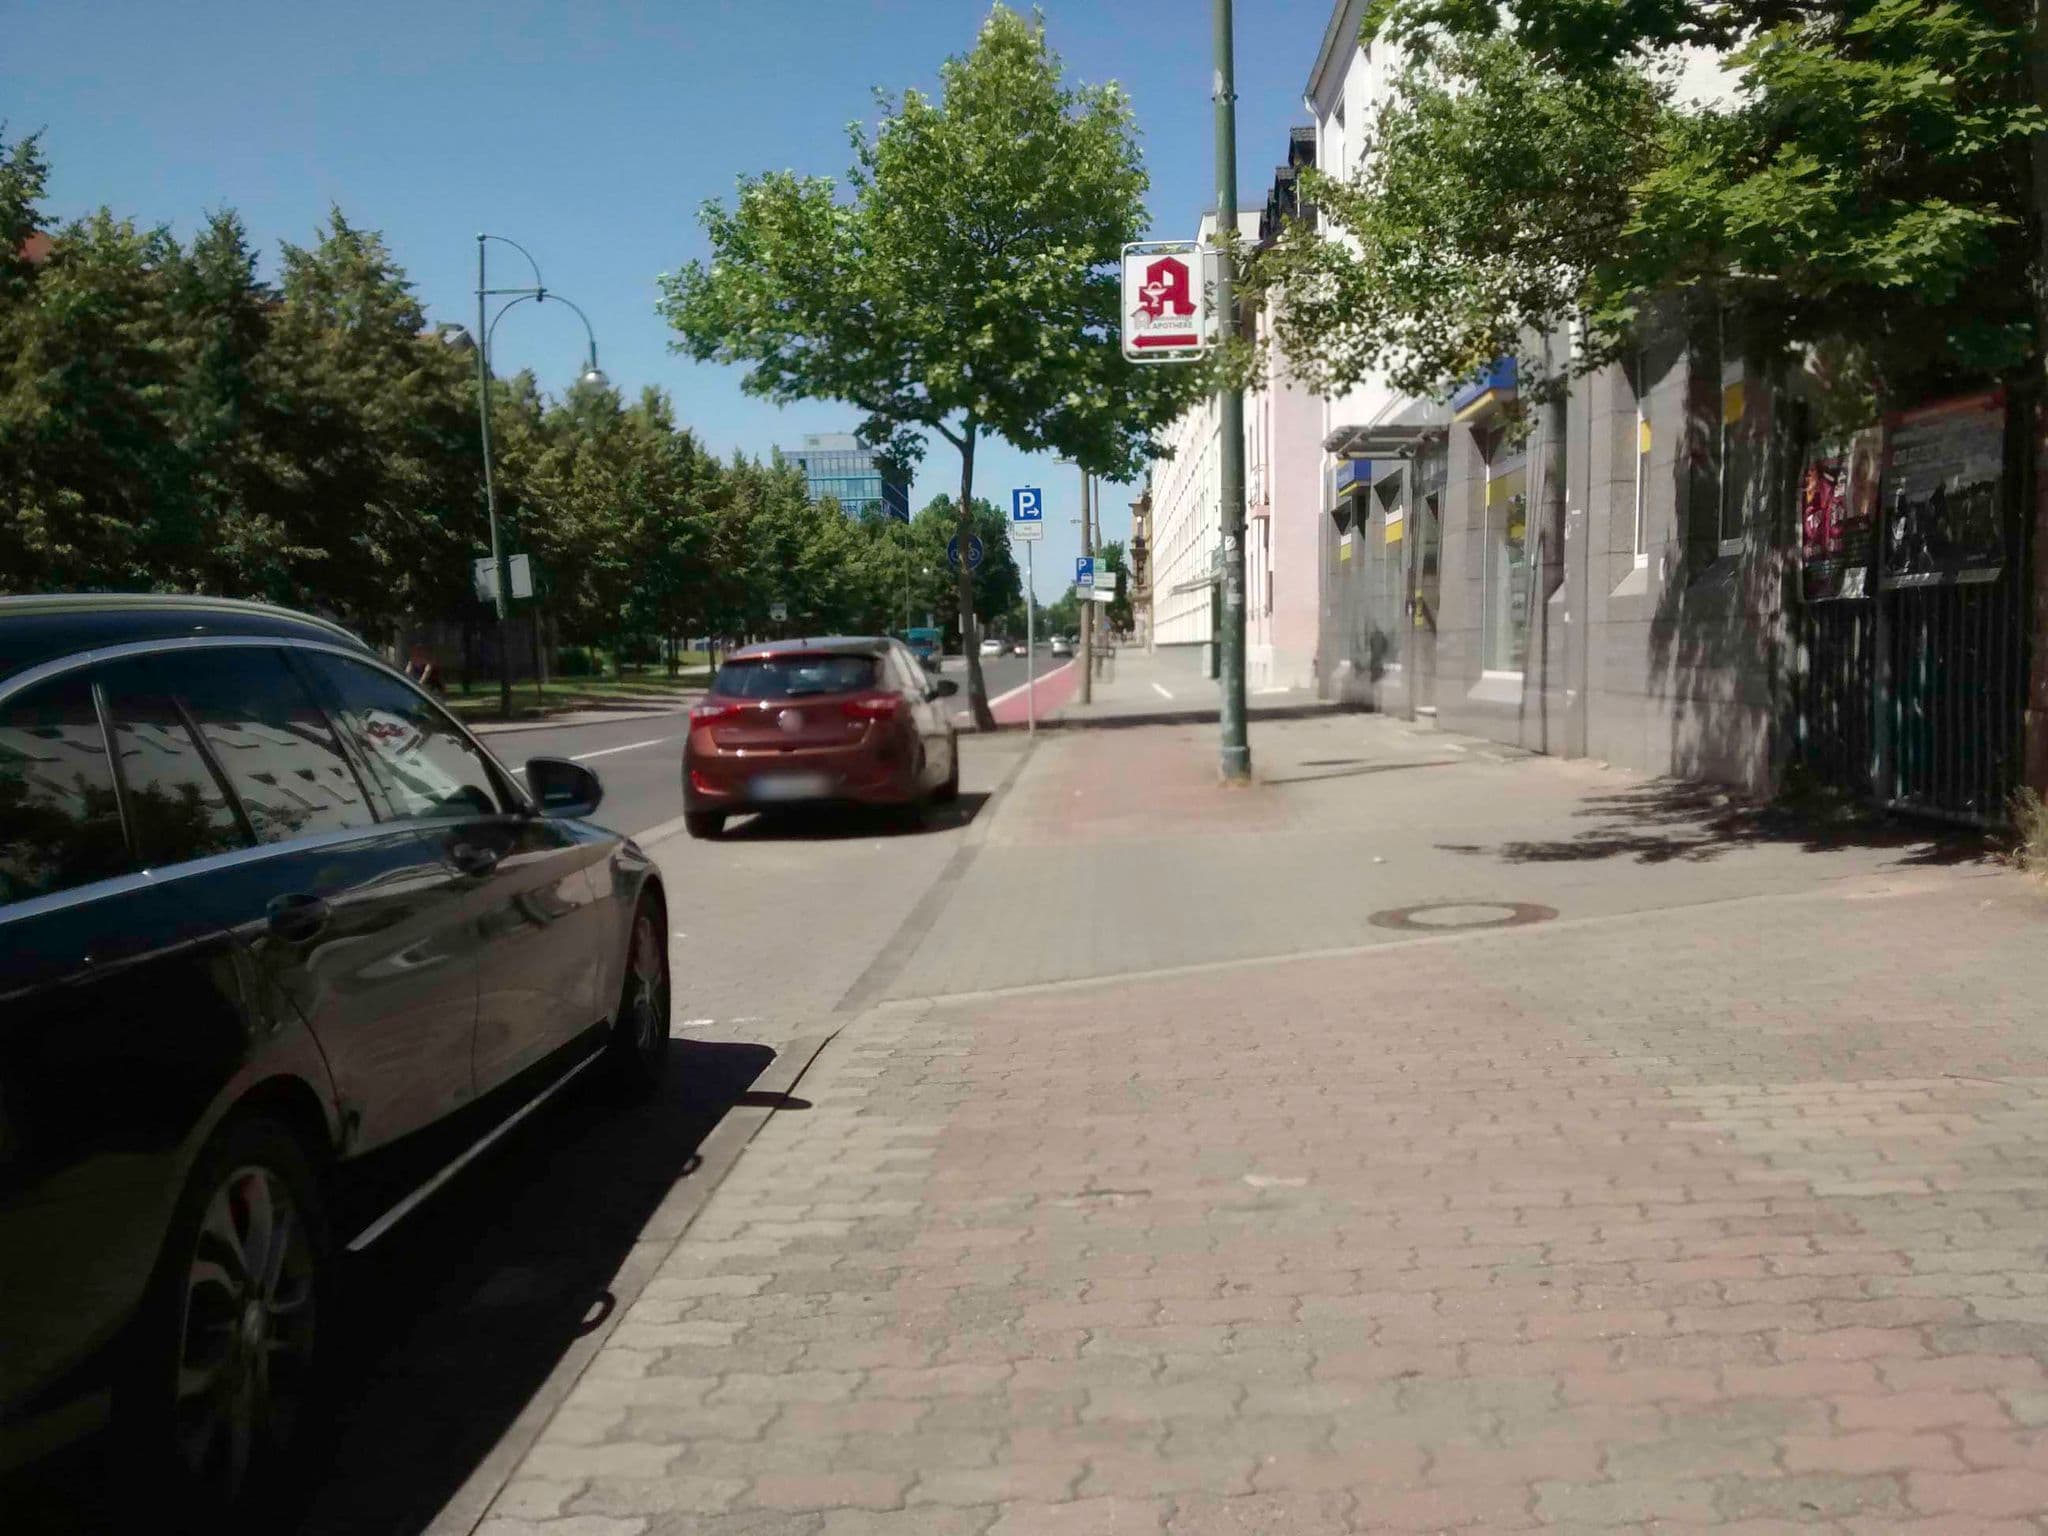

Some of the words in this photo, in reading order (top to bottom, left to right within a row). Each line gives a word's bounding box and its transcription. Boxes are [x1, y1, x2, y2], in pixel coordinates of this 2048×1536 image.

[1152, 322, 1193, 330] APOTHEKE
[1019, 492, 1035, 518] P
[1079, 559, 1087, 571] P
